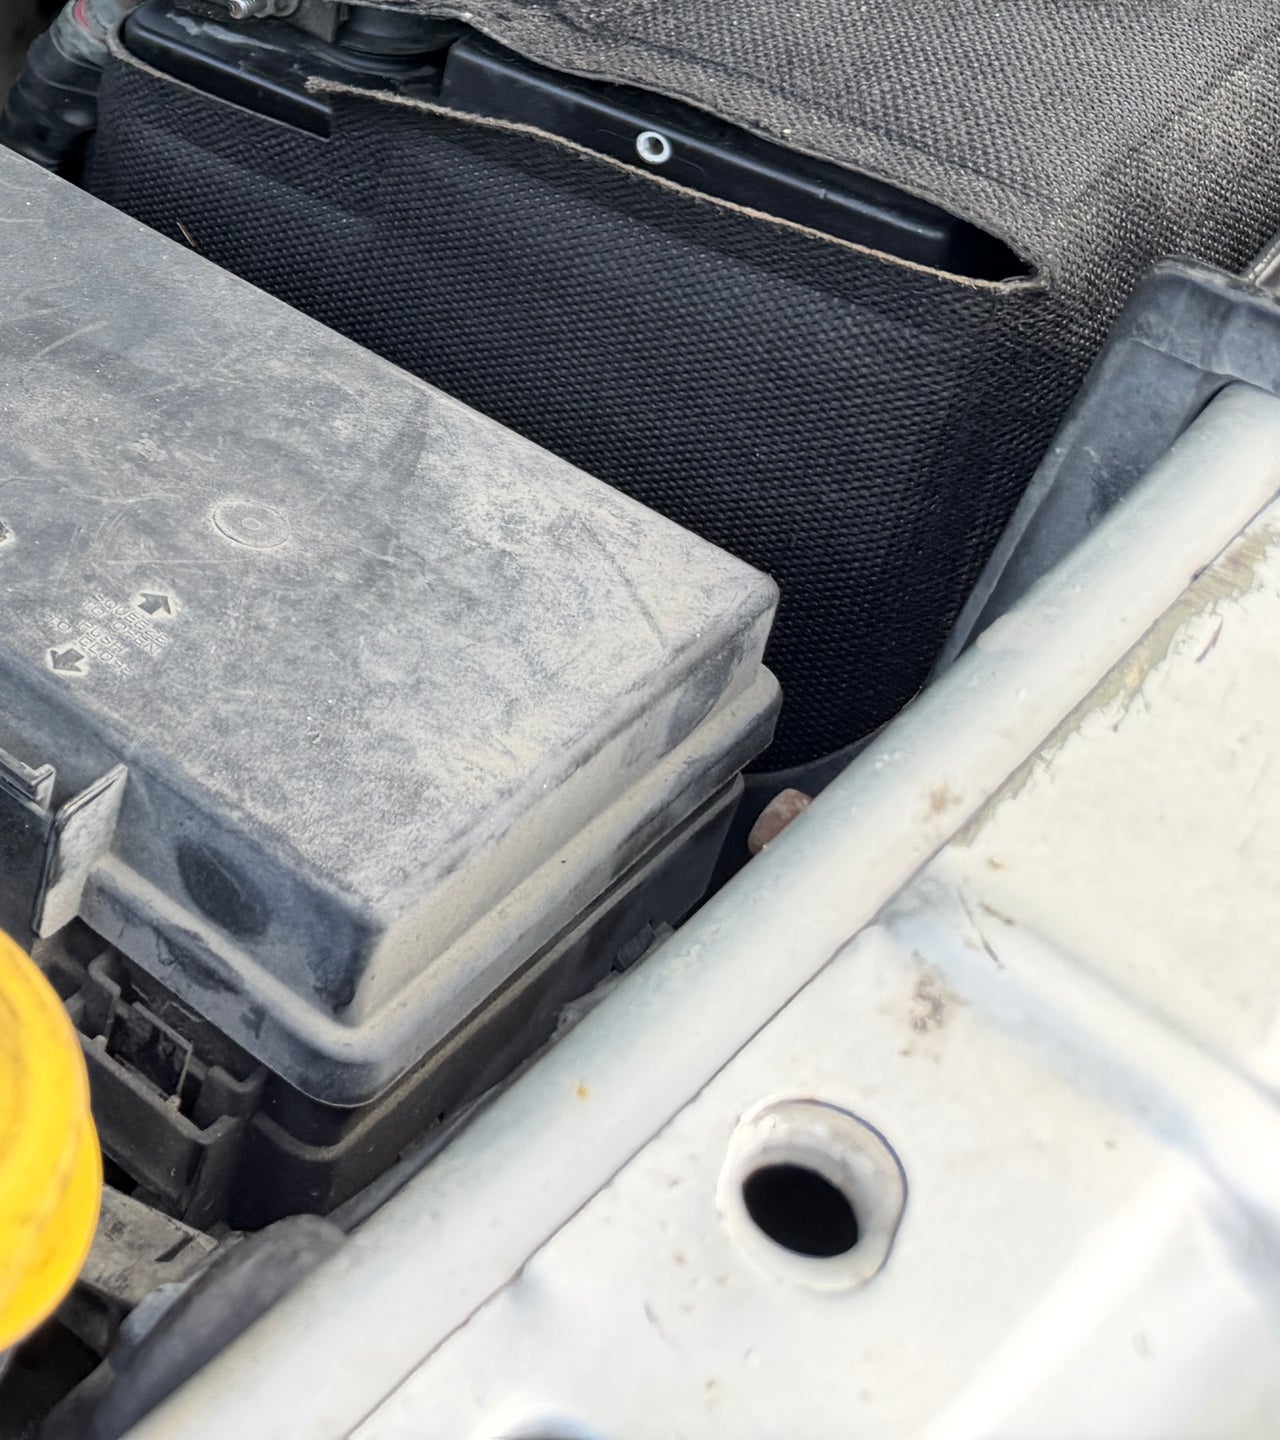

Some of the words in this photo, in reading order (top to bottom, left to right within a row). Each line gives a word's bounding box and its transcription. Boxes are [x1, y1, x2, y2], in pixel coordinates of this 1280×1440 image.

[48, 611, 72, 633] TO
[77, 636, 136, 677] CLOSE
[78, 619, 130, 657] PUSH
[82, 598, 106, 617] TO
[113, 619, 162, 657] OPEN
[92, 592, 170, 648] SQUEEZE
